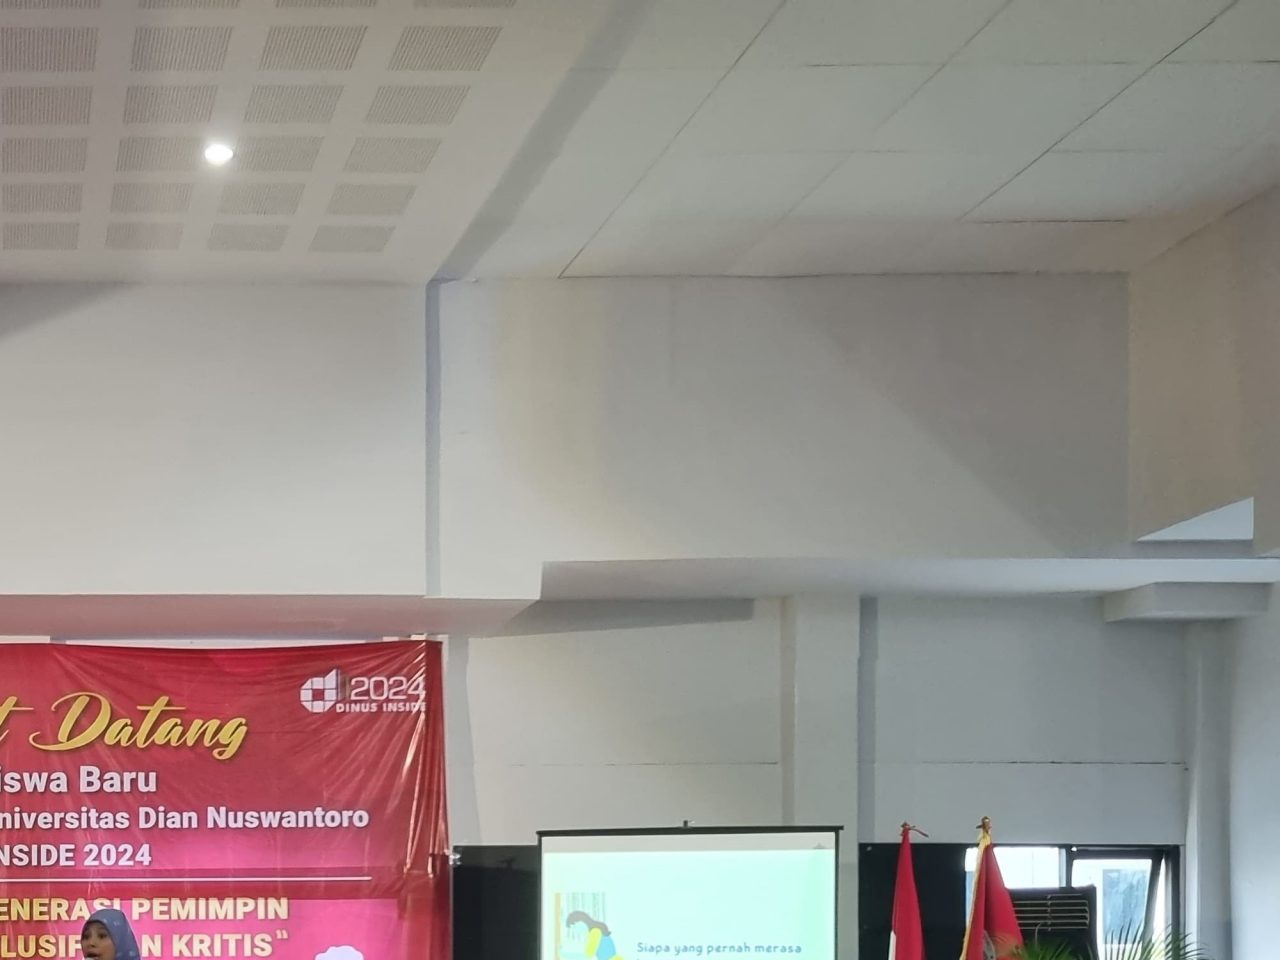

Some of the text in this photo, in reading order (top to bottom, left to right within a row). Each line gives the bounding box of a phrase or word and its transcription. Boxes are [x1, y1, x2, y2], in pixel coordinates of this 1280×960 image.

[350, 676, 426, 700] 2024
[336, 701, 426, 713] DINUS INSIDE
[29, 691, 249, 760] Datang
[78, 765, 157, 793] Baru
[138, 806, 198, 829] Dian
[207, 806, 370, 829] Nuswantoro
[83, 843, 152, 866] 2024
[131, 896, 289, 920] PEMIMPIN
[636, 941, 802, 956] Siapa yang pernah merasa
